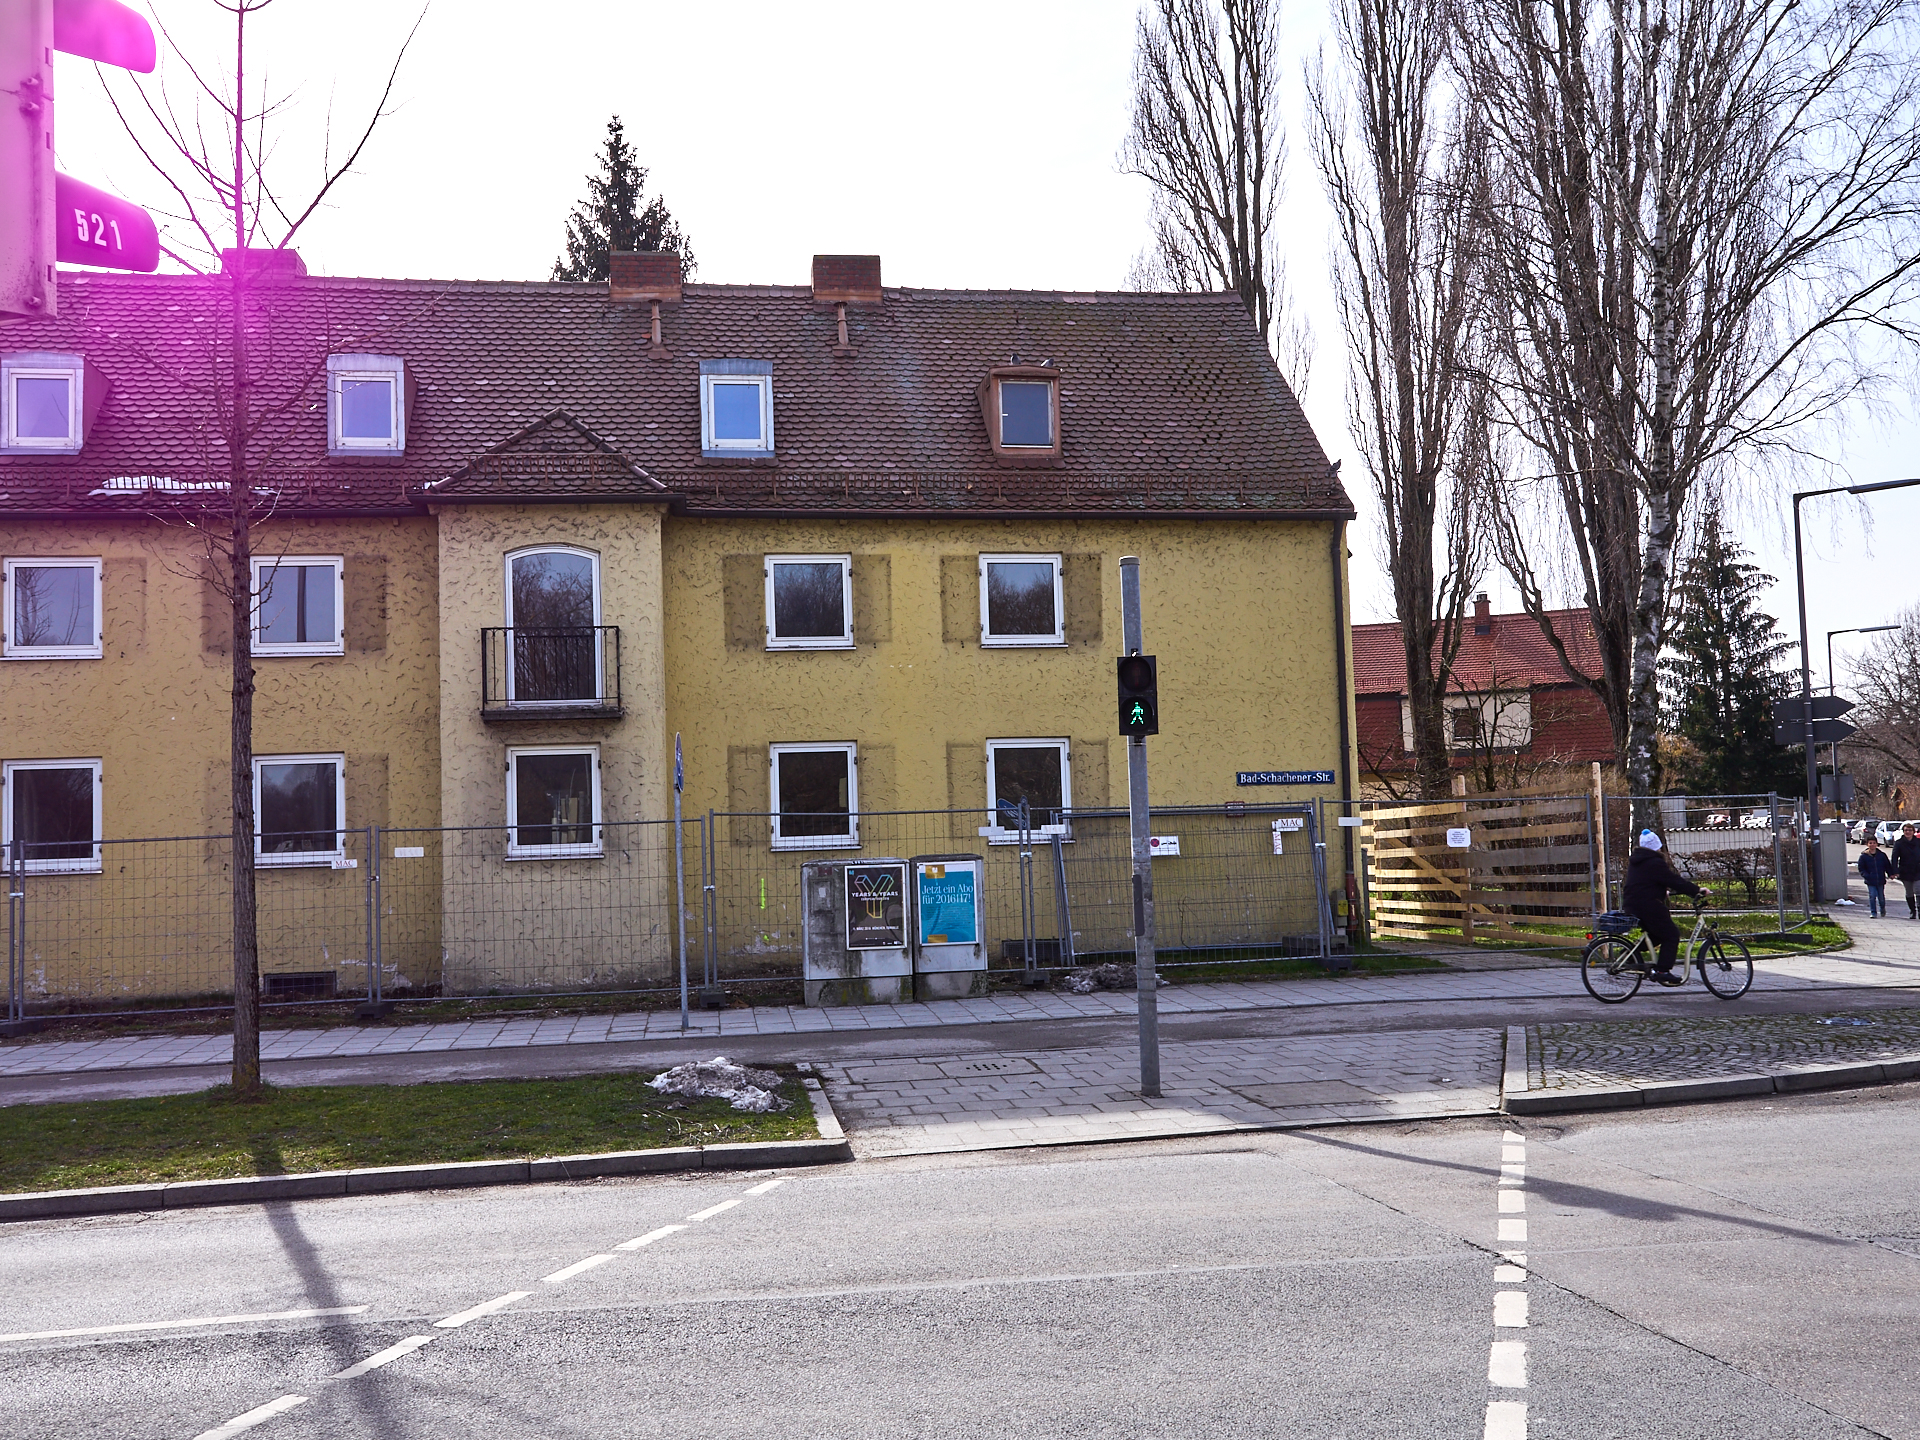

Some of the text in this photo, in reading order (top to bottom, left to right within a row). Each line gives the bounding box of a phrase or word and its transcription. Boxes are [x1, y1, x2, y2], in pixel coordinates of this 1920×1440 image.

[74, 208, 122, 250] 521
[1240, 772, 1330, 784] Bad-Schachener-Str.
[1280, 818, 1302, 827] MAC
[335, 860, 353, 868] MAC
[921, 884, 973, 894] Jetzt ein Abo
[922, 895, 935, 905] für
